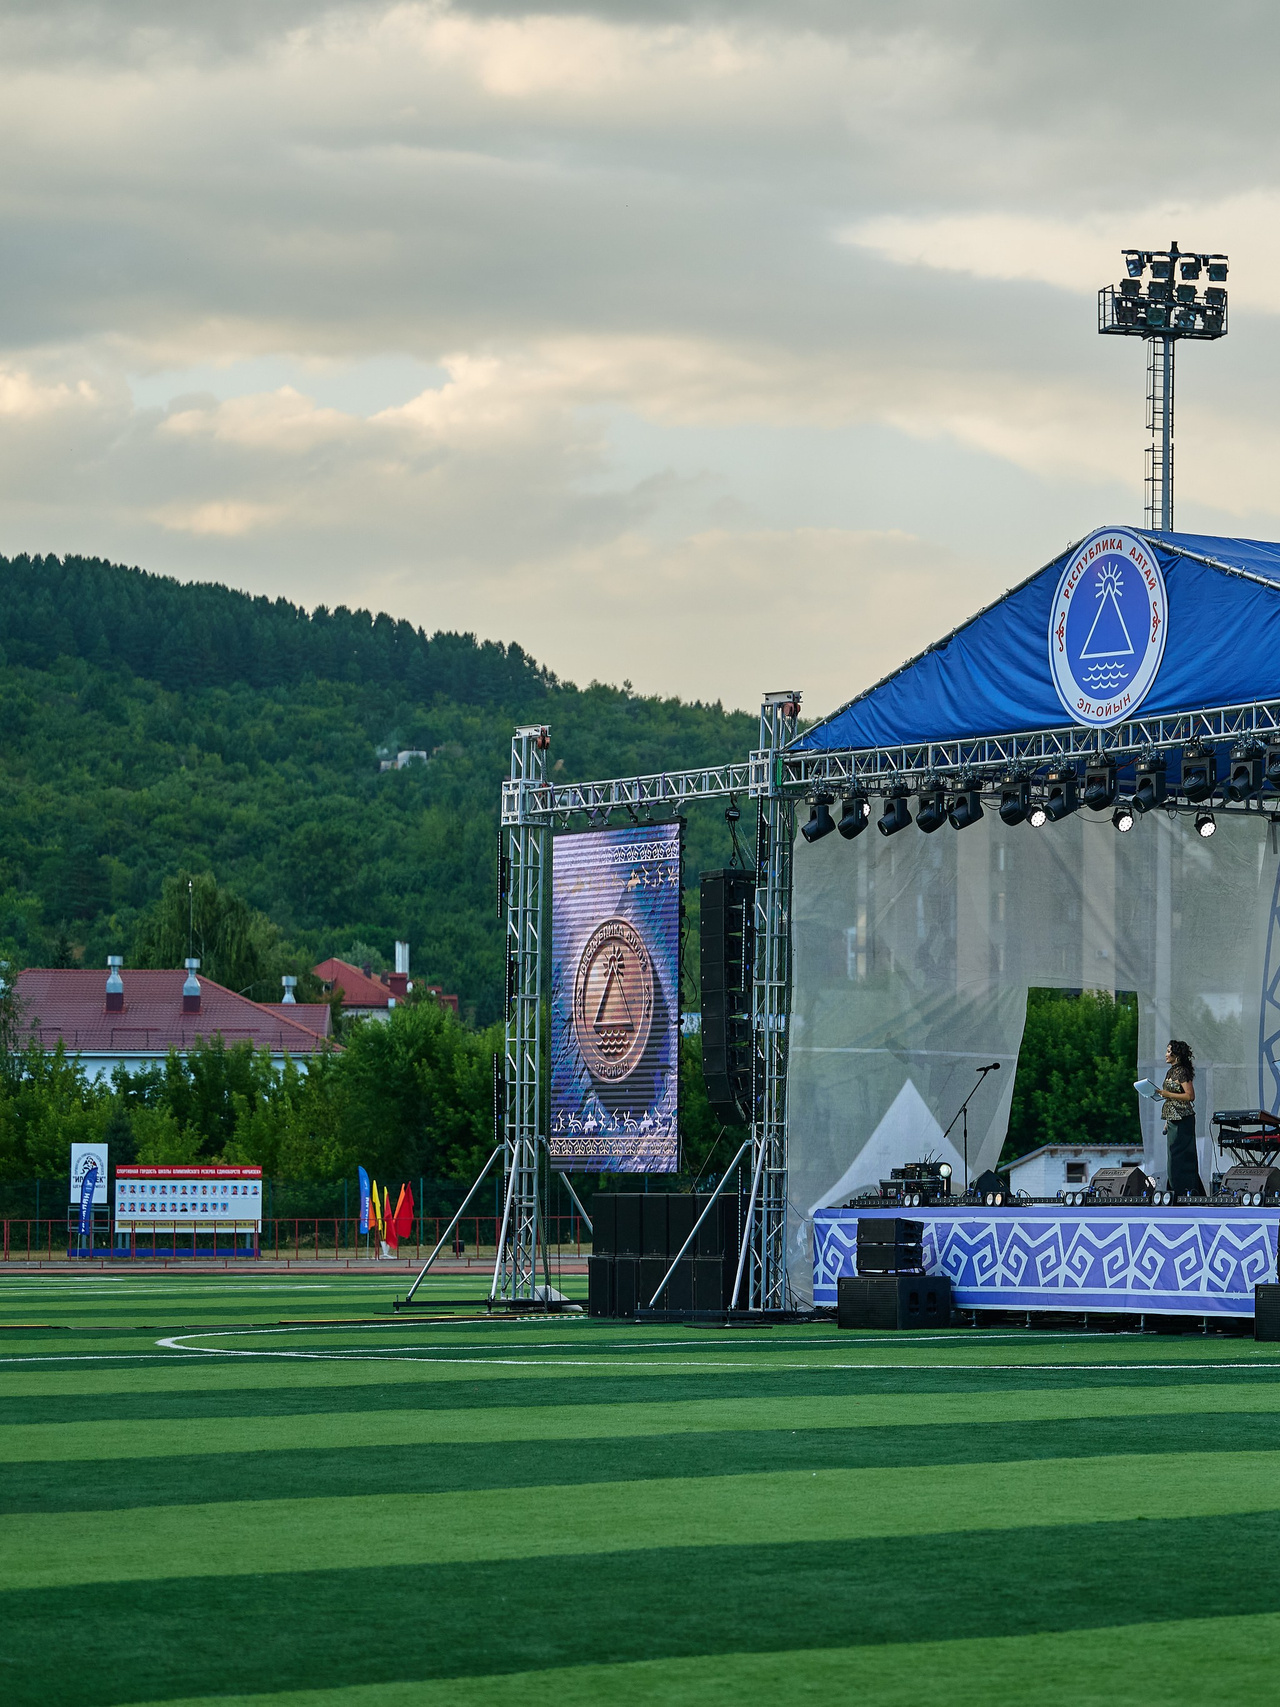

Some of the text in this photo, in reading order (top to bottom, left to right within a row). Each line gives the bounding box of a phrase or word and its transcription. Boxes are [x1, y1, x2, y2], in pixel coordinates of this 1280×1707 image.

[1063, 538, 1158, 600] РЕСПУБЛИКА АЛТАЙ
[1076, 693, 1131, 717] ЭЛ-ОЙЫН
